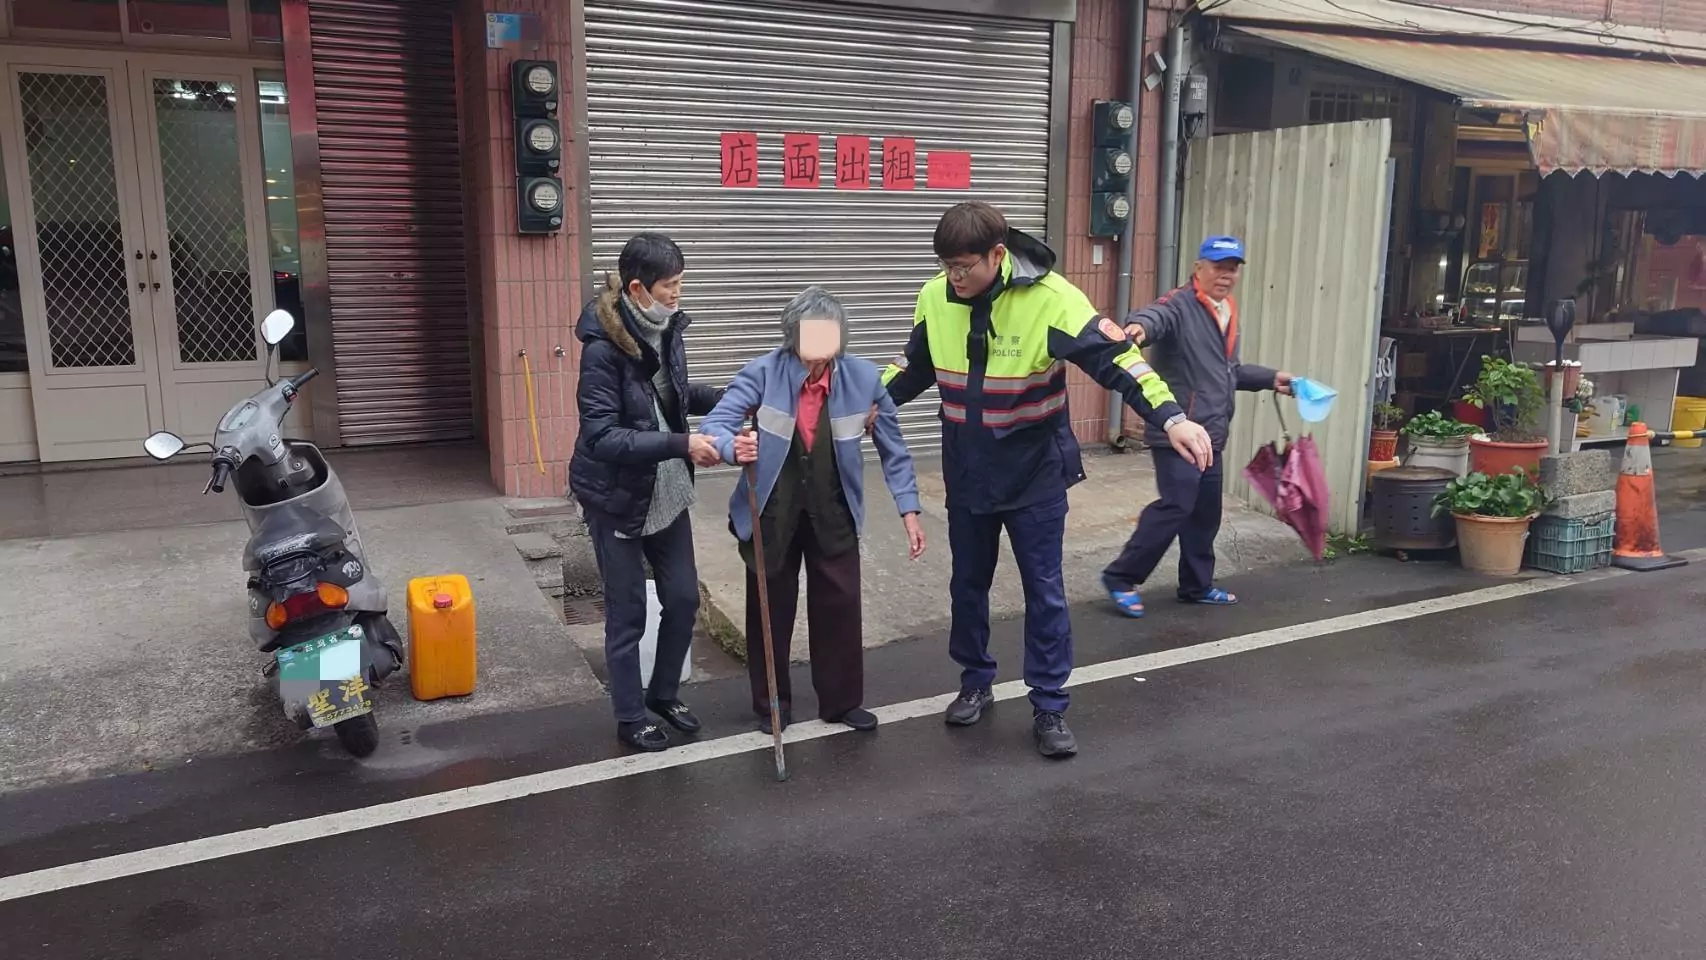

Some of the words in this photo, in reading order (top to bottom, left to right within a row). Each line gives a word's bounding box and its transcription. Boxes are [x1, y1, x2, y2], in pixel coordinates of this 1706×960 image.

[724, 139, 914, 184] 店面出租
[992, 348, 1022, 358] POLICE
